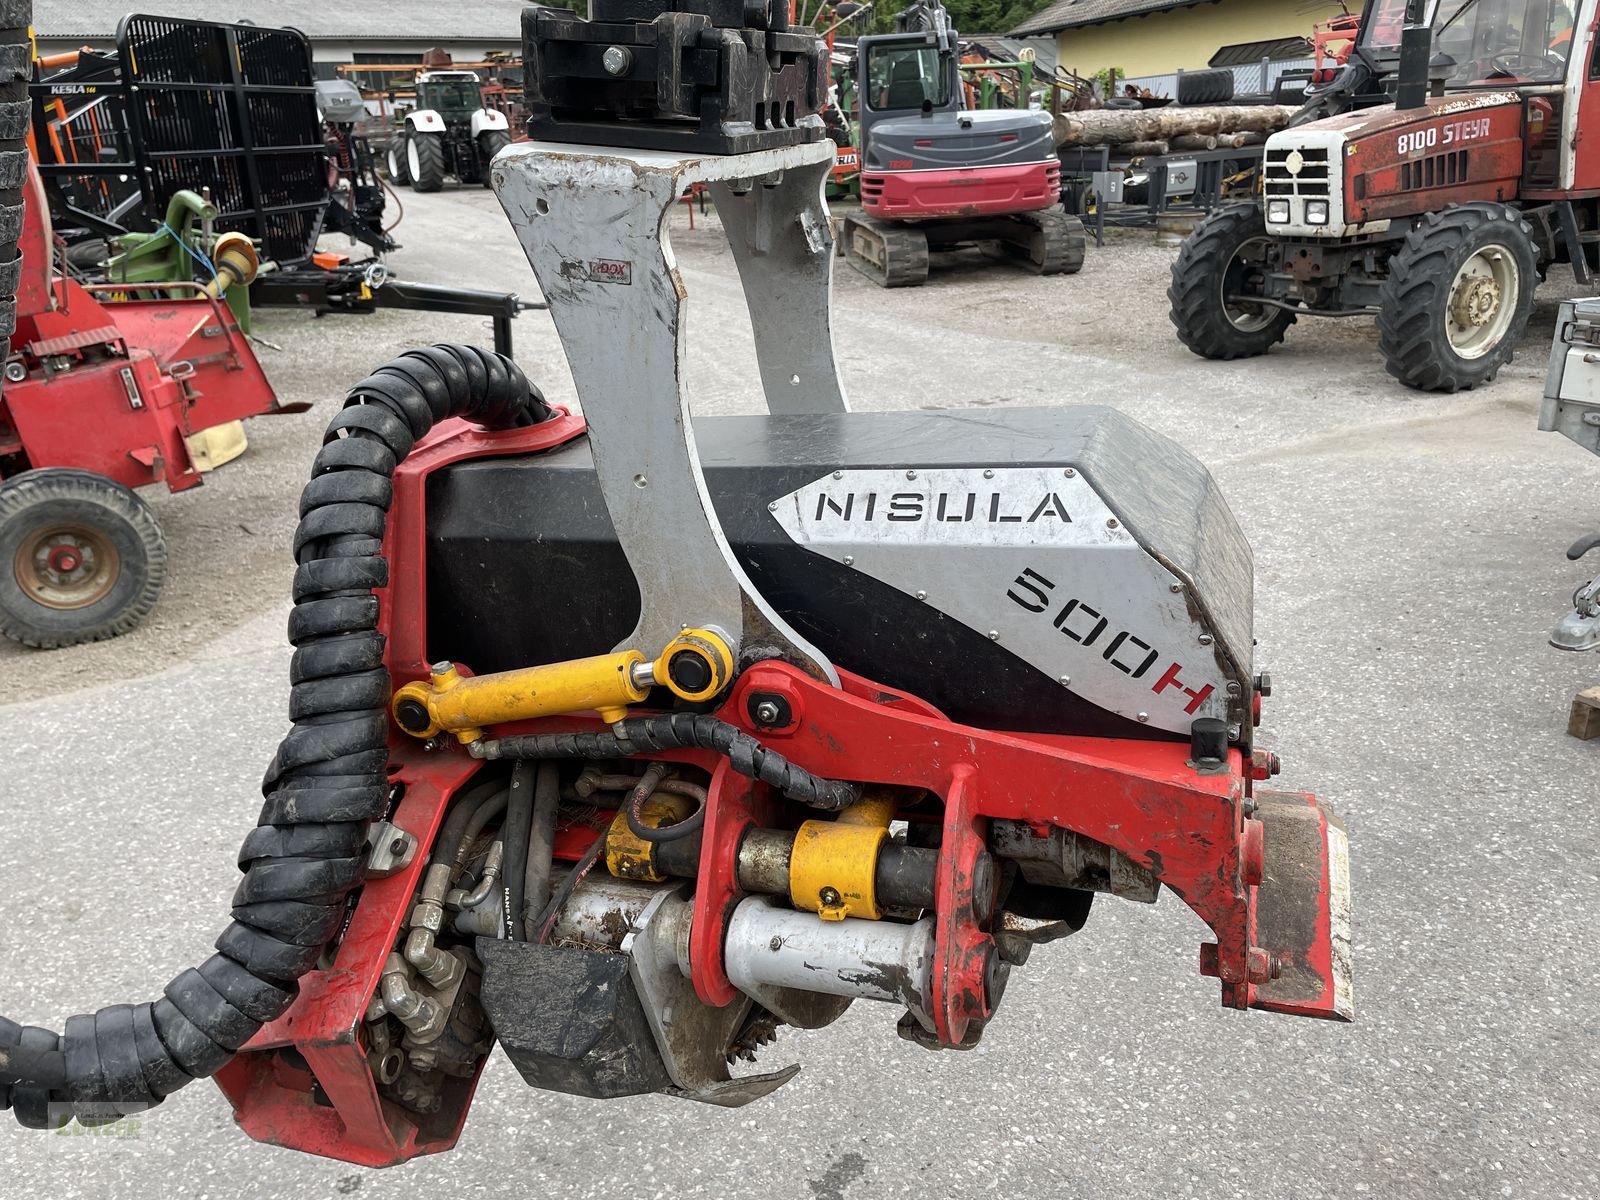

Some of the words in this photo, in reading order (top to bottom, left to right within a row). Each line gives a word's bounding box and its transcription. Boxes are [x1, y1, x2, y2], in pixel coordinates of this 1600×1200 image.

[51, 85, 85, 94] KESLA
[1398, 128, 1437, 154] 8100
[1442, 118, 1490, 144] STEYR
[815, 493, 1073, 522] NISULA
[1006, 567, 1216, 715] 500H
